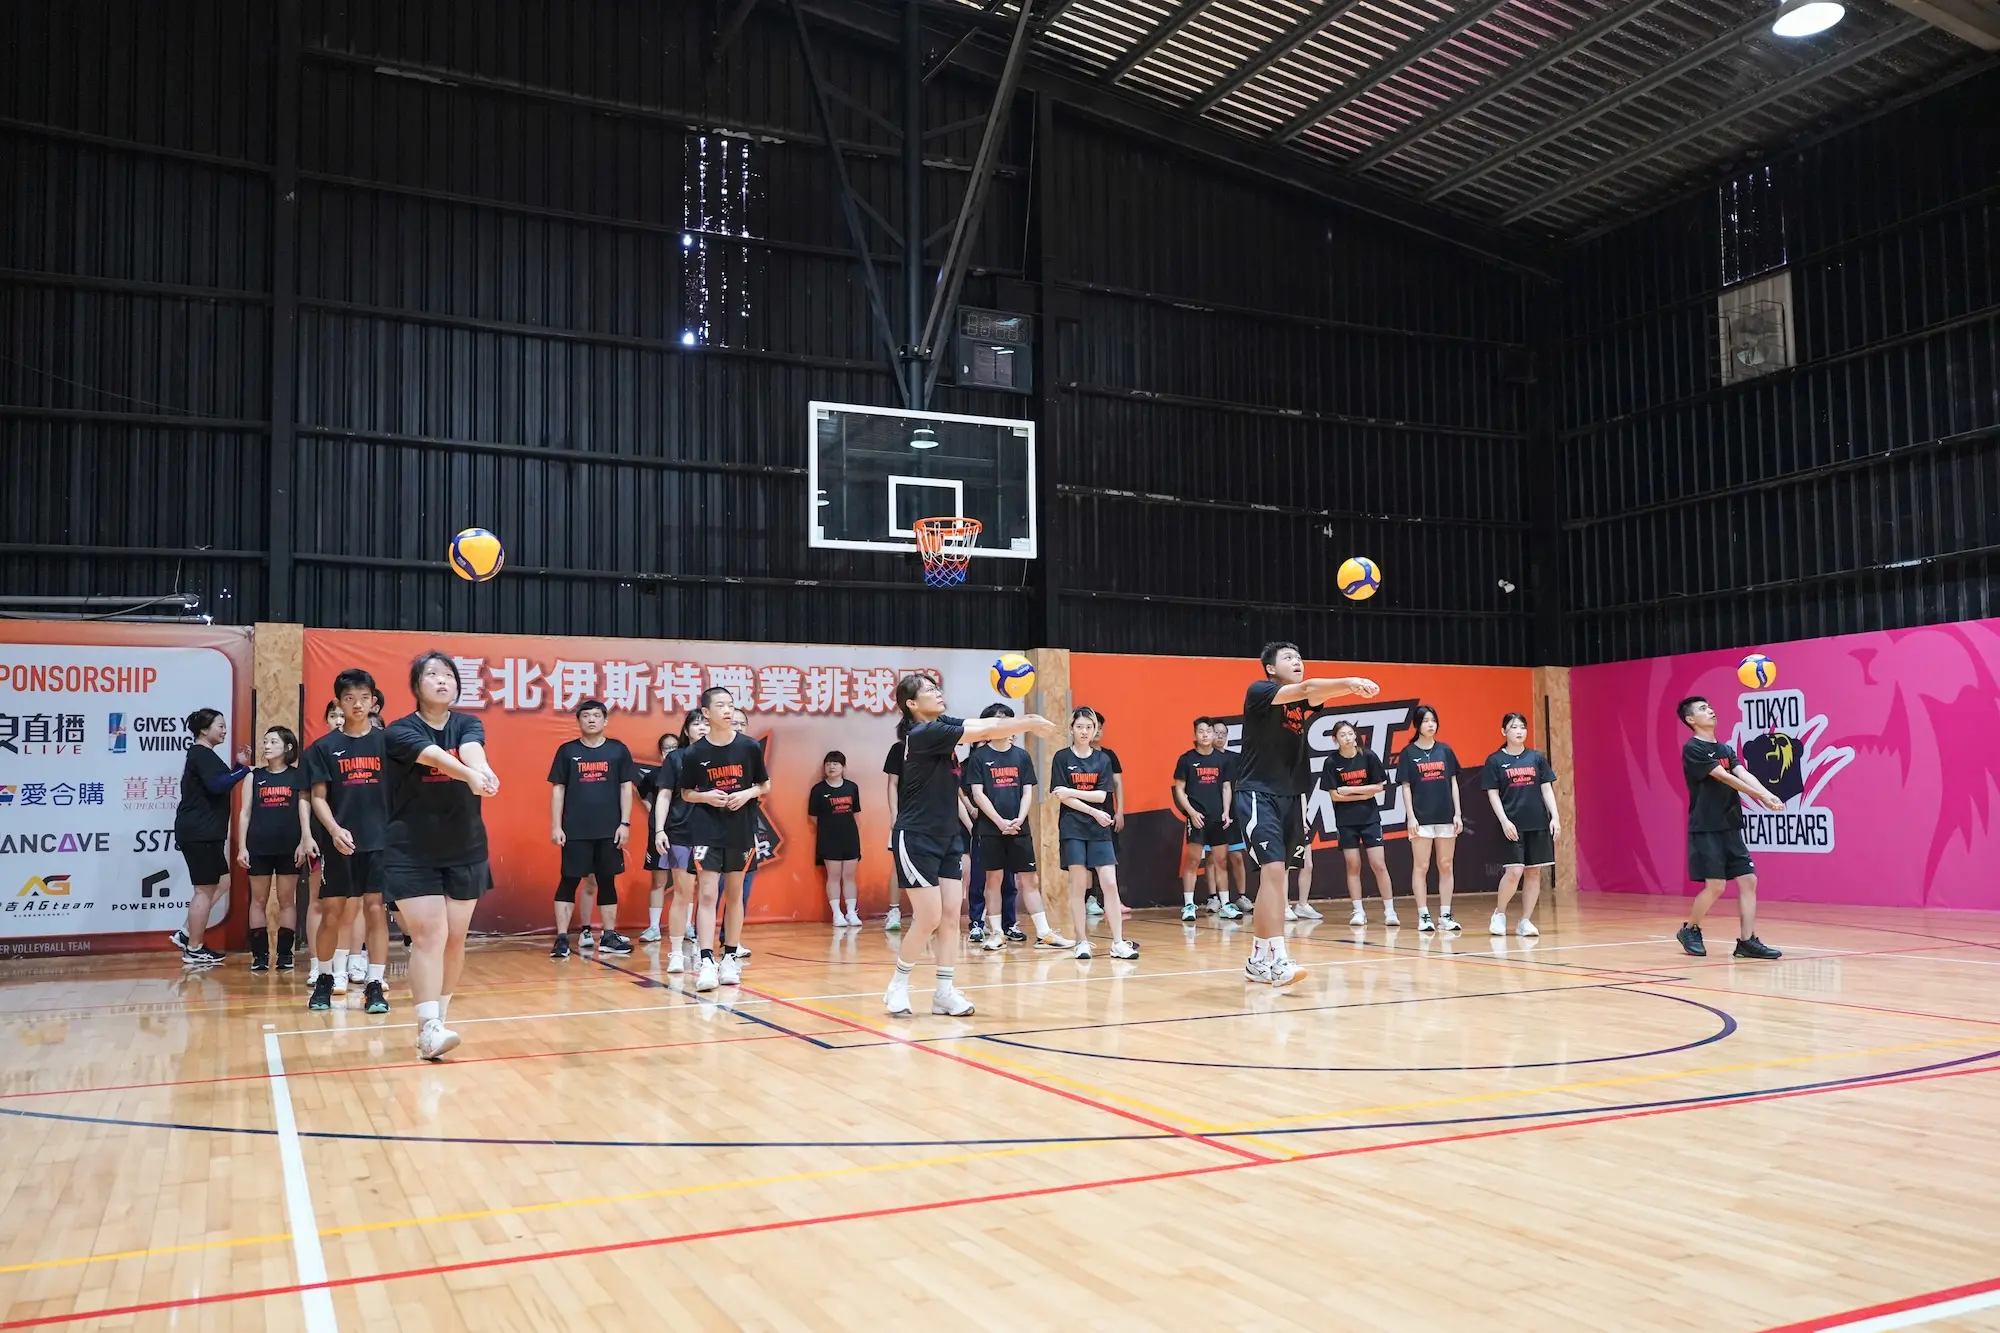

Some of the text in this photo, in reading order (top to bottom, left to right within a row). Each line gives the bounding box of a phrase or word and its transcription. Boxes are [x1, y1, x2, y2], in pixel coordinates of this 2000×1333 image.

[0, 665, 157, 692] PONSORSHIP
[452, 656, 943, 714] 臺北伊斯特職業排球
[1744, 696, 1799, 729] TOKYO
[134, 717, 176, 733] GIVES
[25, 745, 81, 755] LIVE
[139, 736, 195, 751] WIIING
[338, 757, 381, 773] TRAINING
[577, 761, 608, 772] TRAINING
[1417, 761, 1445, 773] TRAINING
[348, 771, 373, 779] CAMP
[707, 765, 743, 781] TRAINING
[990, 767, 1019, 778] TRAINING
[1340, 769, 1367, 782] TRAINING
[1505, 767, 1536, 779] TRAINING
[716, 779, 737, 787] CAMP
[21, 782, 104, 806] 愛合購
[259, 786, 292, 798] TRAINING
[123, 802, 178, 810] SUPERCUR
[1741, 814, 1828, 845] REATBEARS
[112, 901, 191, 911] POWERHOUS
[12, 942, 65, 954] VOLLEYBALL
[68, 941, 90, 952] TEAM
